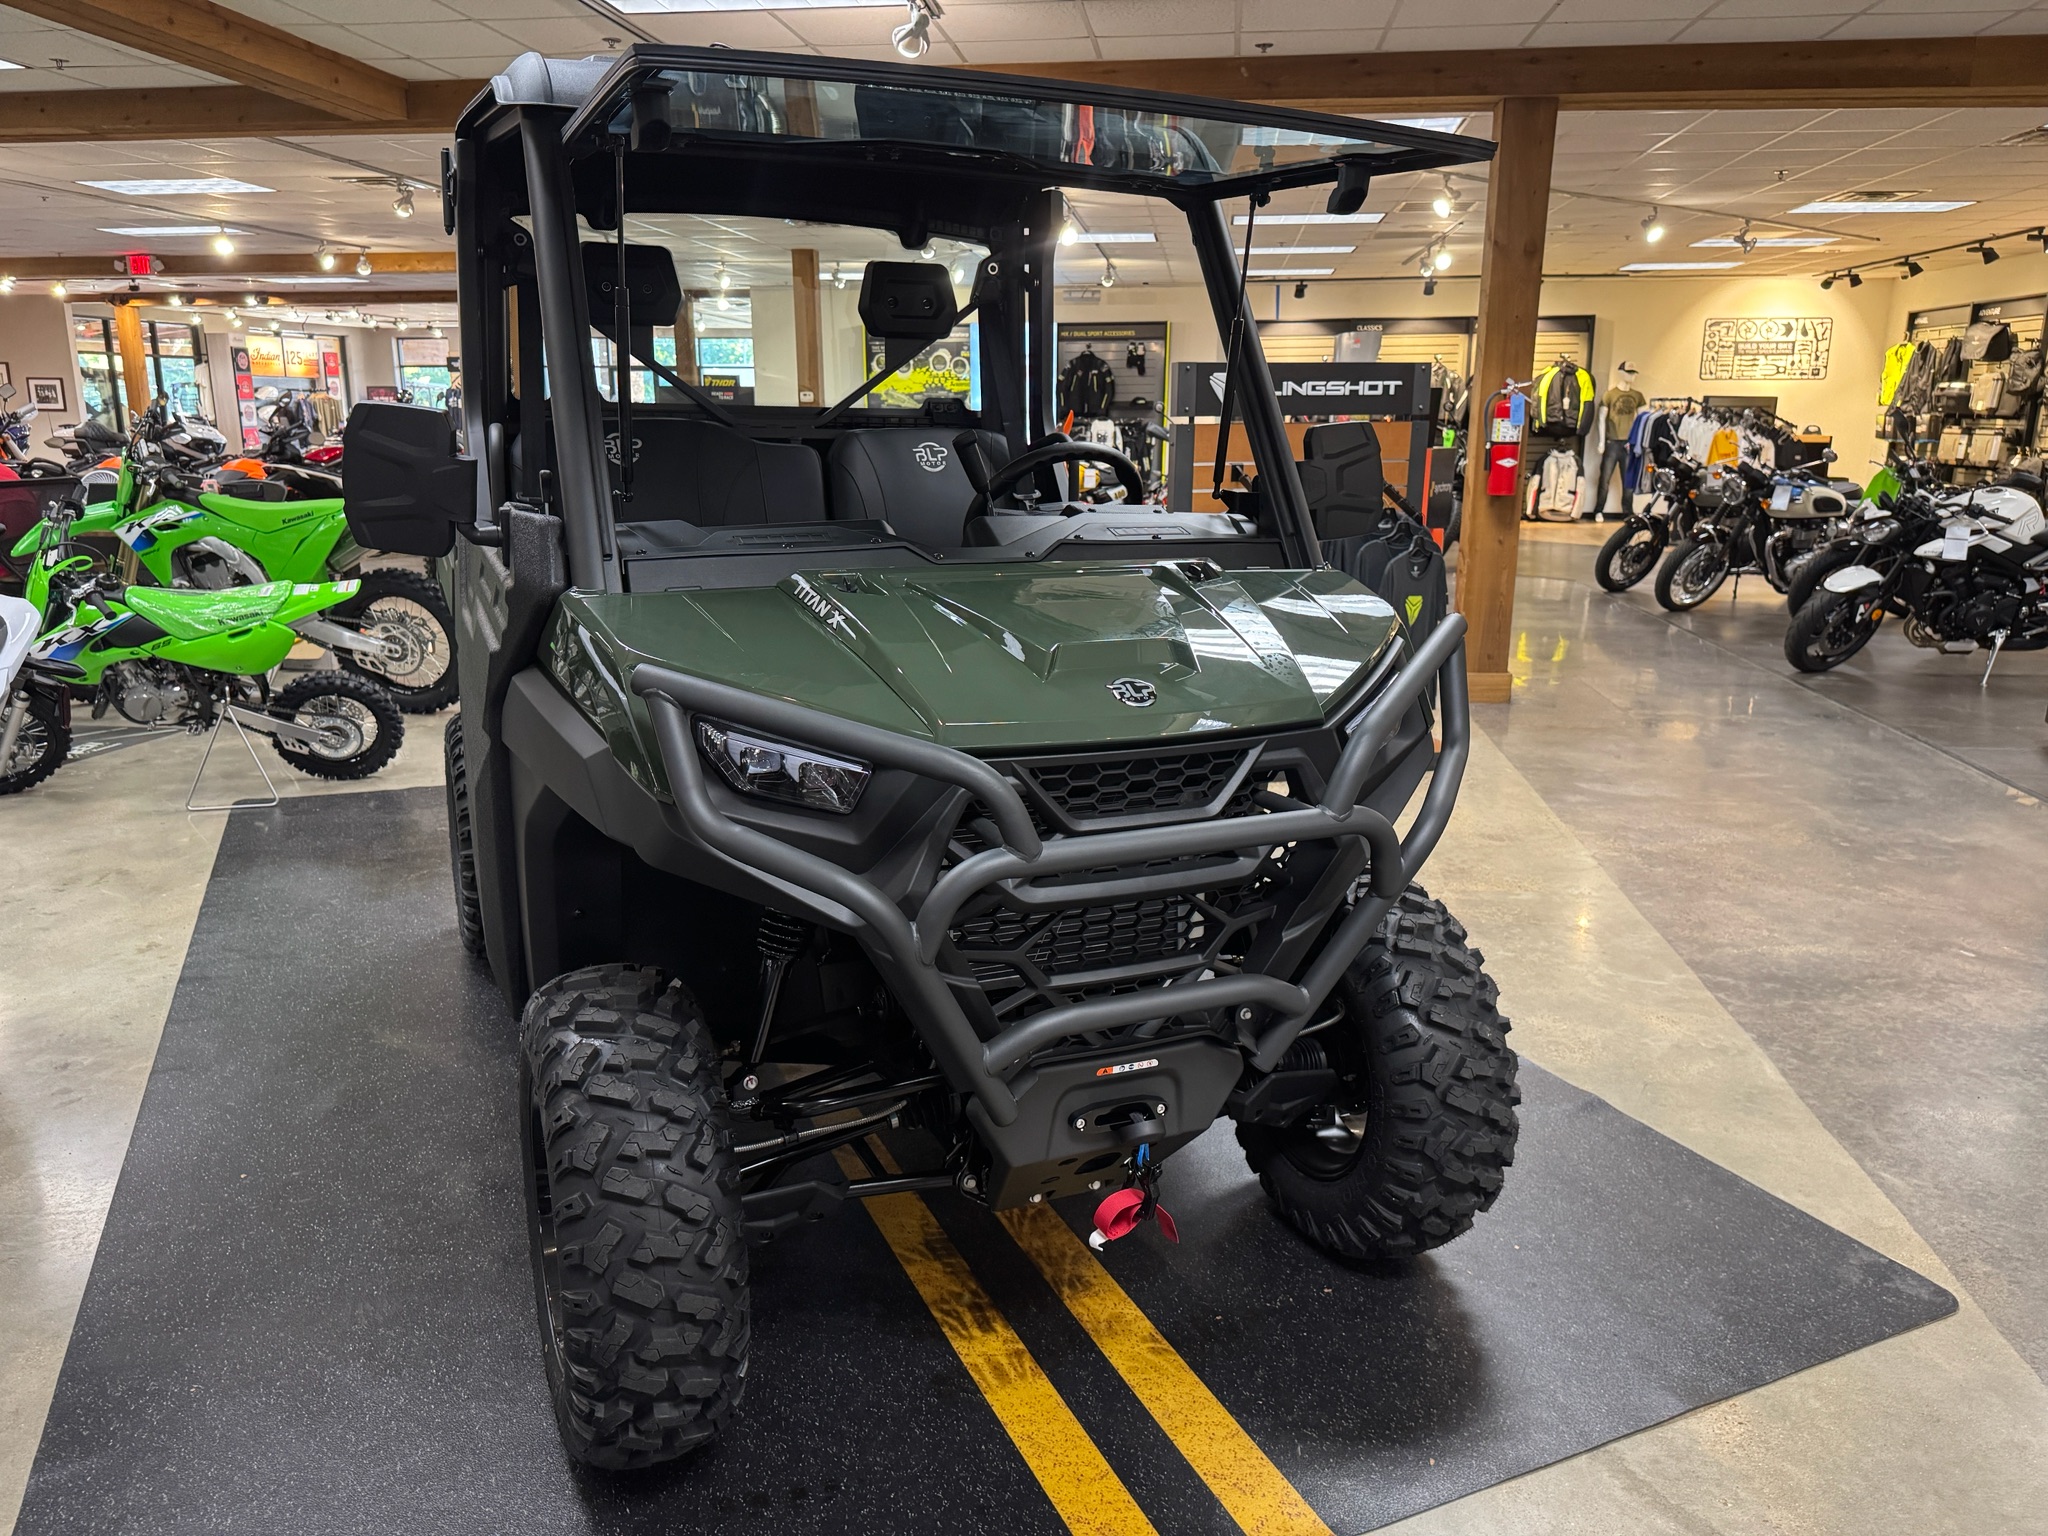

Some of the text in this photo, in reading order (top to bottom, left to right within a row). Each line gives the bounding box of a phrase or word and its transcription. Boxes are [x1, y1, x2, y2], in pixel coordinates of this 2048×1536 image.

[130, 256, 150, 274] EXIT
[250, 348, 281, 361] Indian
[285, 350, 303, 366] 125
[711, 379, 736, 387] THOR
[1275, 381, 1403, 396] INGSHOT
[604, 438, 643, 454] BP
[912, 447, 948, 462] BLP
[282, 511, 314, 525] Kawasaki
[792, 575, 832, 618] TITAN
[217, 608, 264, 626] Kawasaki
[36, 617, 110, 653] KX
